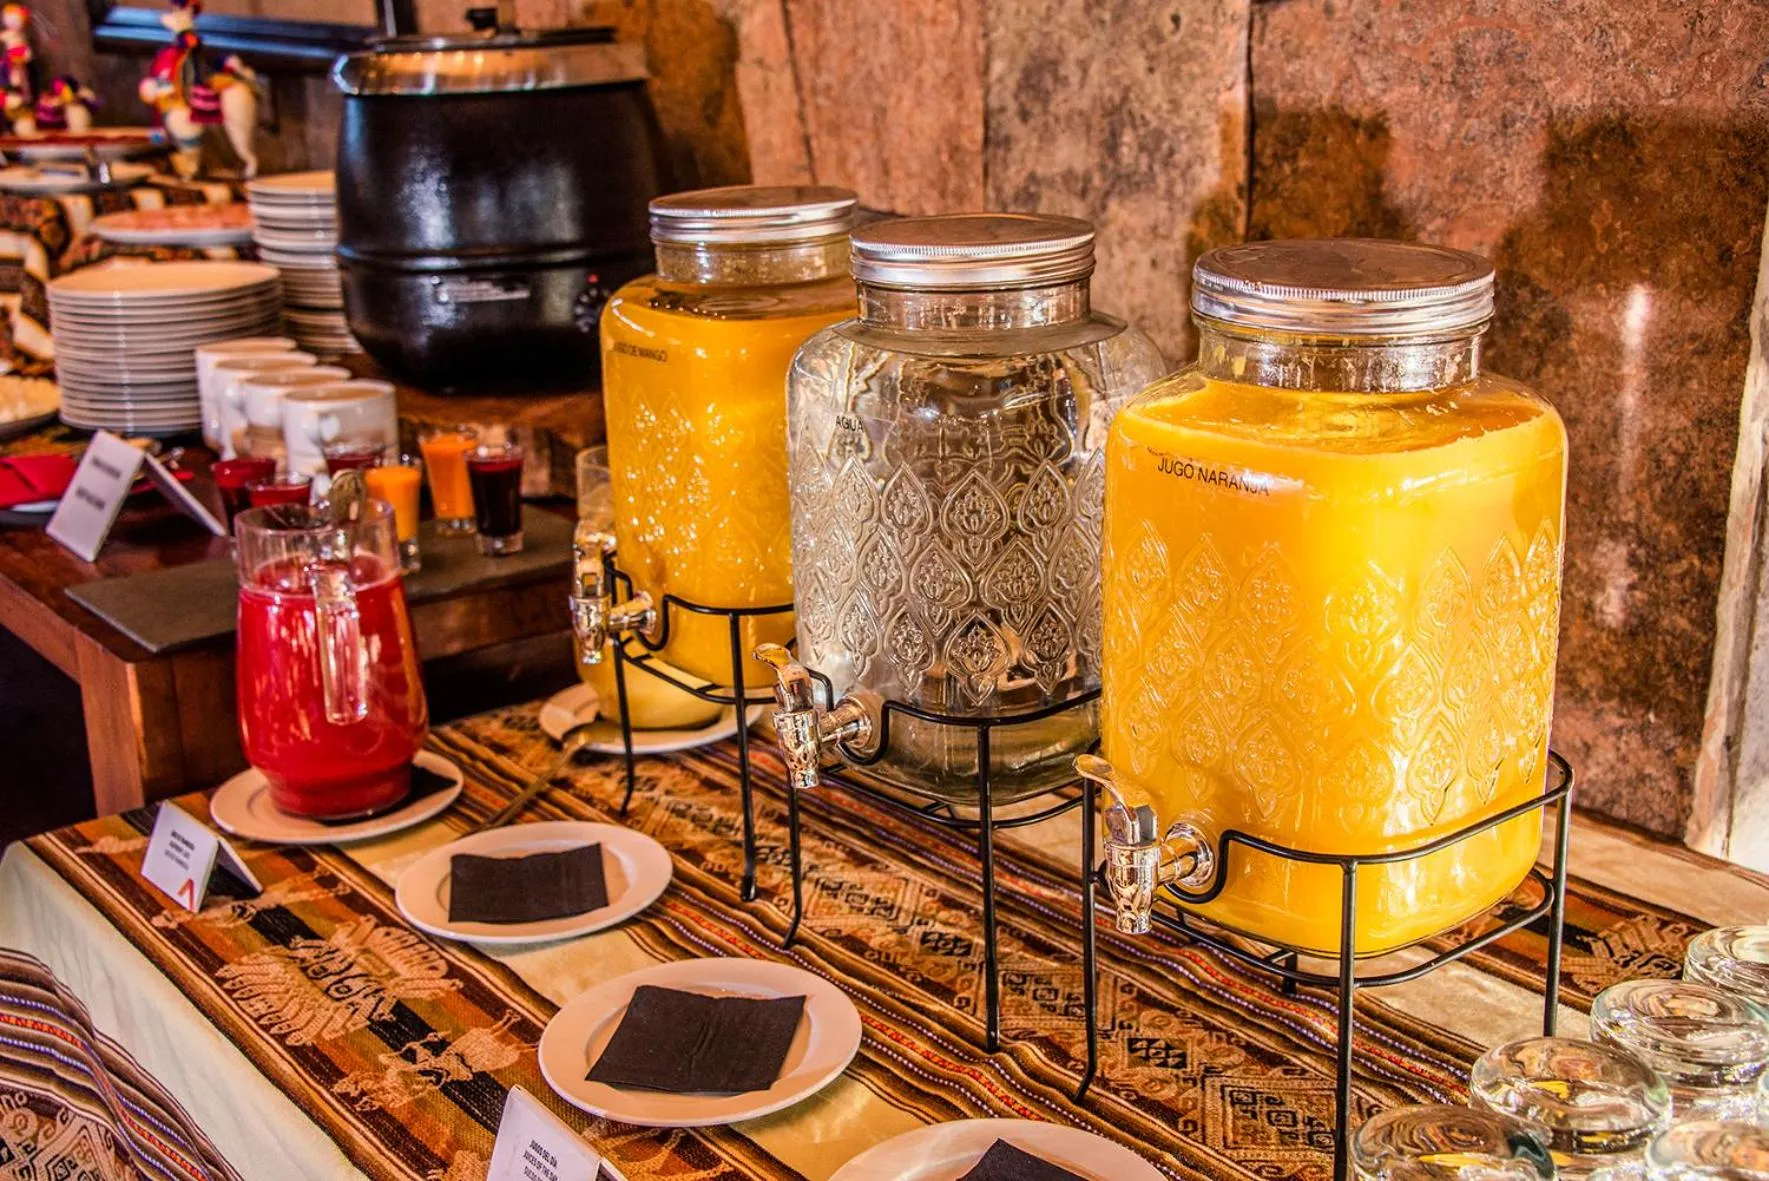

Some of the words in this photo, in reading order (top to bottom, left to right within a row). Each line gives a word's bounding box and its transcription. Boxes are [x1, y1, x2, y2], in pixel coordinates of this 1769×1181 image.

[835, 415, 864, 433] AGUA
[1157, 457, 1194, 479] JUGO
[1198, 467, 1270, 496] NARANJA
